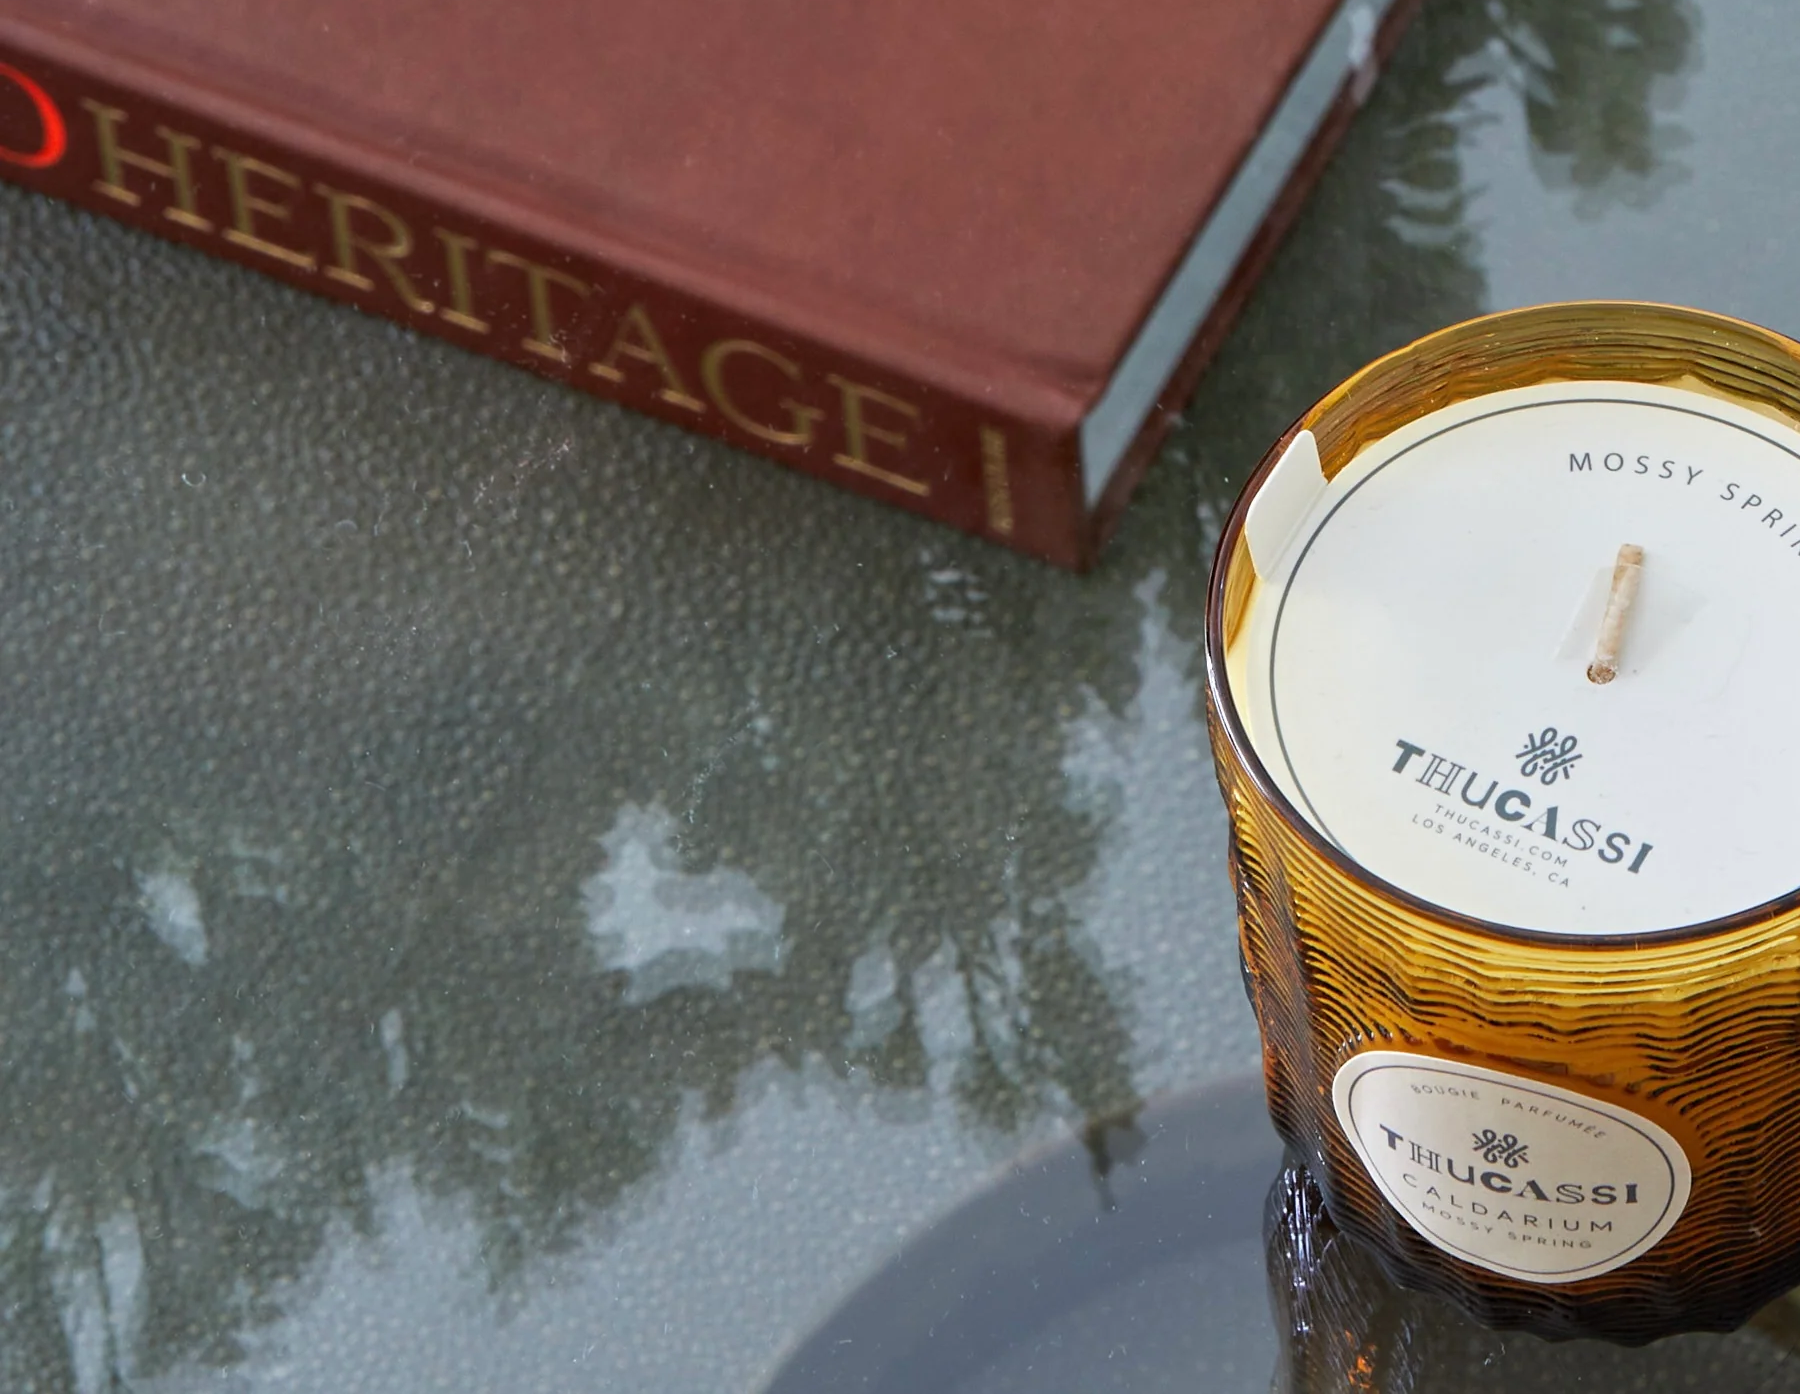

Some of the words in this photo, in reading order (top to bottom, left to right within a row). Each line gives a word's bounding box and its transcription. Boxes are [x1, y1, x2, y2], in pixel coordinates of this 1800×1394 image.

[81, 96, 931, 497] HERITAGE
[1568, 451, 1704, 487] MOSSY
[1391, 738, 1655, 875] THUCASSI
[1434, 803, 1569, 869] THUCASSI.COM
[1410, 813, 1446, 835] LOS
[1547, 871, 1571, 889] CA
[1410, 1083, 1481, 1101] BOUGIE
[1379, 1122, 1640, 1205] THUCASSI
[1402, 1173, 1614, 1234] CALDARIUM
[1421, 1200, 1496, 1235] MOSSY
[1507, 1230, 1593, 1250] SPRING
